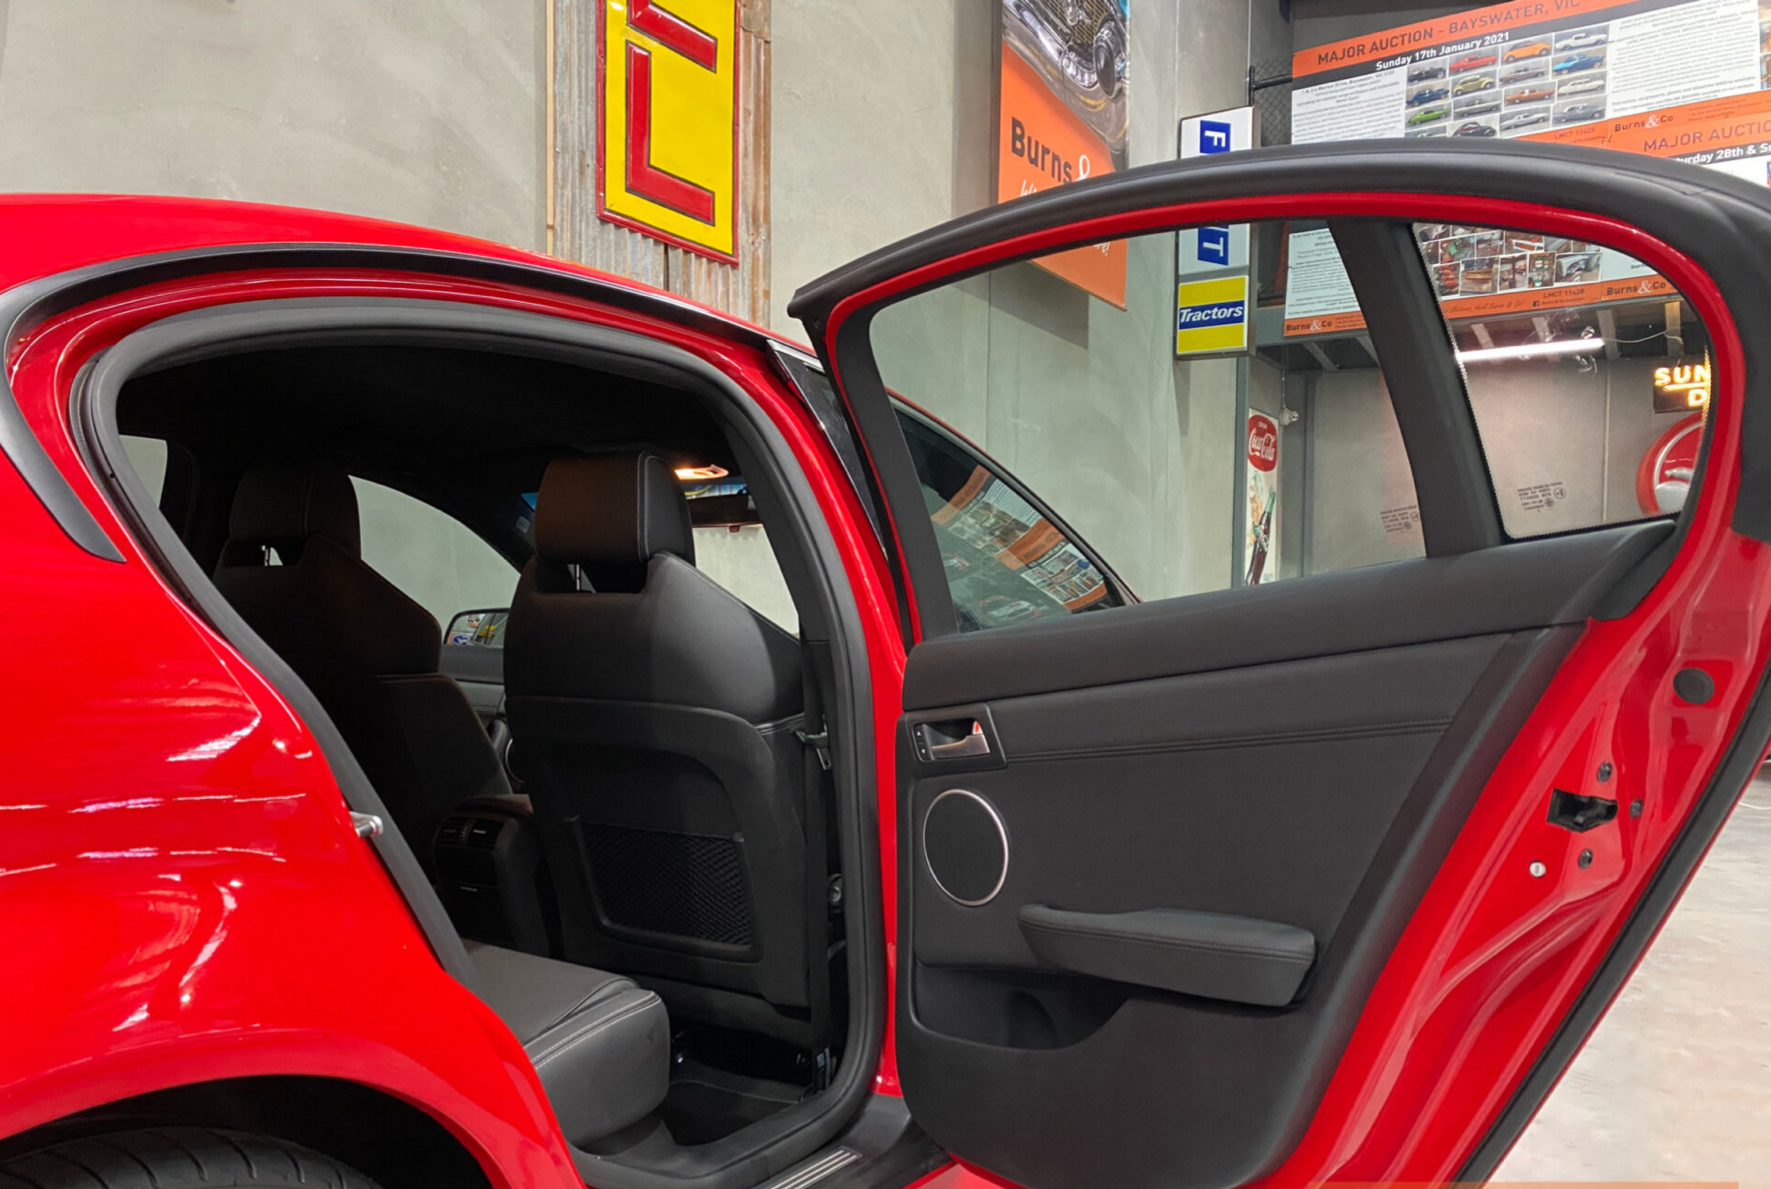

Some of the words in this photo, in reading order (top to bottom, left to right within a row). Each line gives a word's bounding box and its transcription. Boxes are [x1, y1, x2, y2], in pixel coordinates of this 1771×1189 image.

[1317, 44, 1366, 65] MAJOR
[1368, 27, 1434, 54] AUCTION
[1449, 3, 1550, 34] BAYSWATER,
[1554, 0, 1580, 10] VIC
[1375, 56, 1412, 71] Sunday
[1414, 48, 1437, 61] 17th
[1438, 39, 1482, 56] January
[1483, 32, 1510, 45] 2021
[1643, 131, 1703, 152] MAJOR
[1716, 147, 1744, 160] 28th
[1747, 144, 1757, 155] &
[1179, 304, 1243, 323] Tractors
